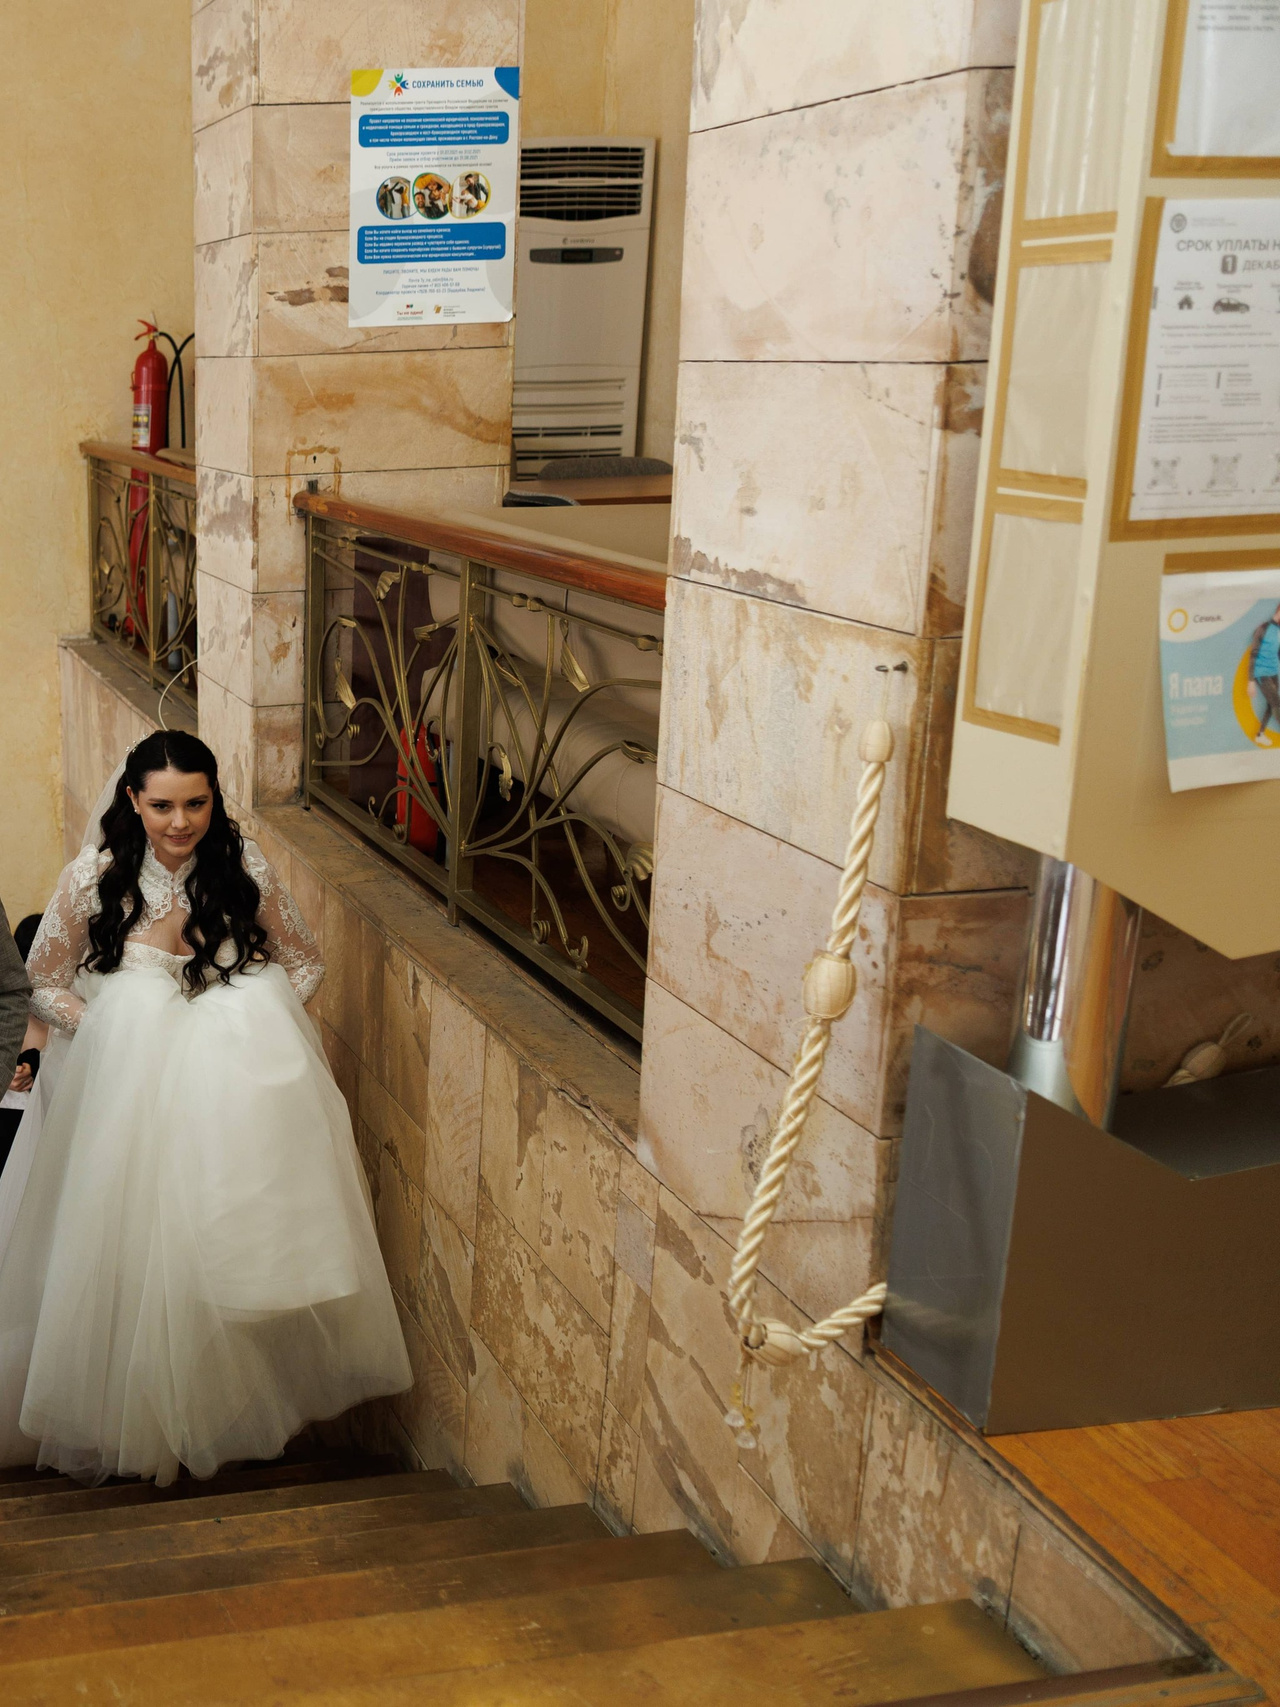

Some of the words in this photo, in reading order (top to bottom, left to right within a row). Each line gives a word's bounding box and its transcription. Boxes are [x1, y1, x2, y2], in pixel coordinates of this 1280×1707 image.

[412, 79, 454, 89] СОХРАНИТЬ
[456, 79, 484, 88] СЕМЬЮ
[1176, 239, 1212, 252] СРОК
[1217, 239, 1269, 251] УПЛАТЫ
